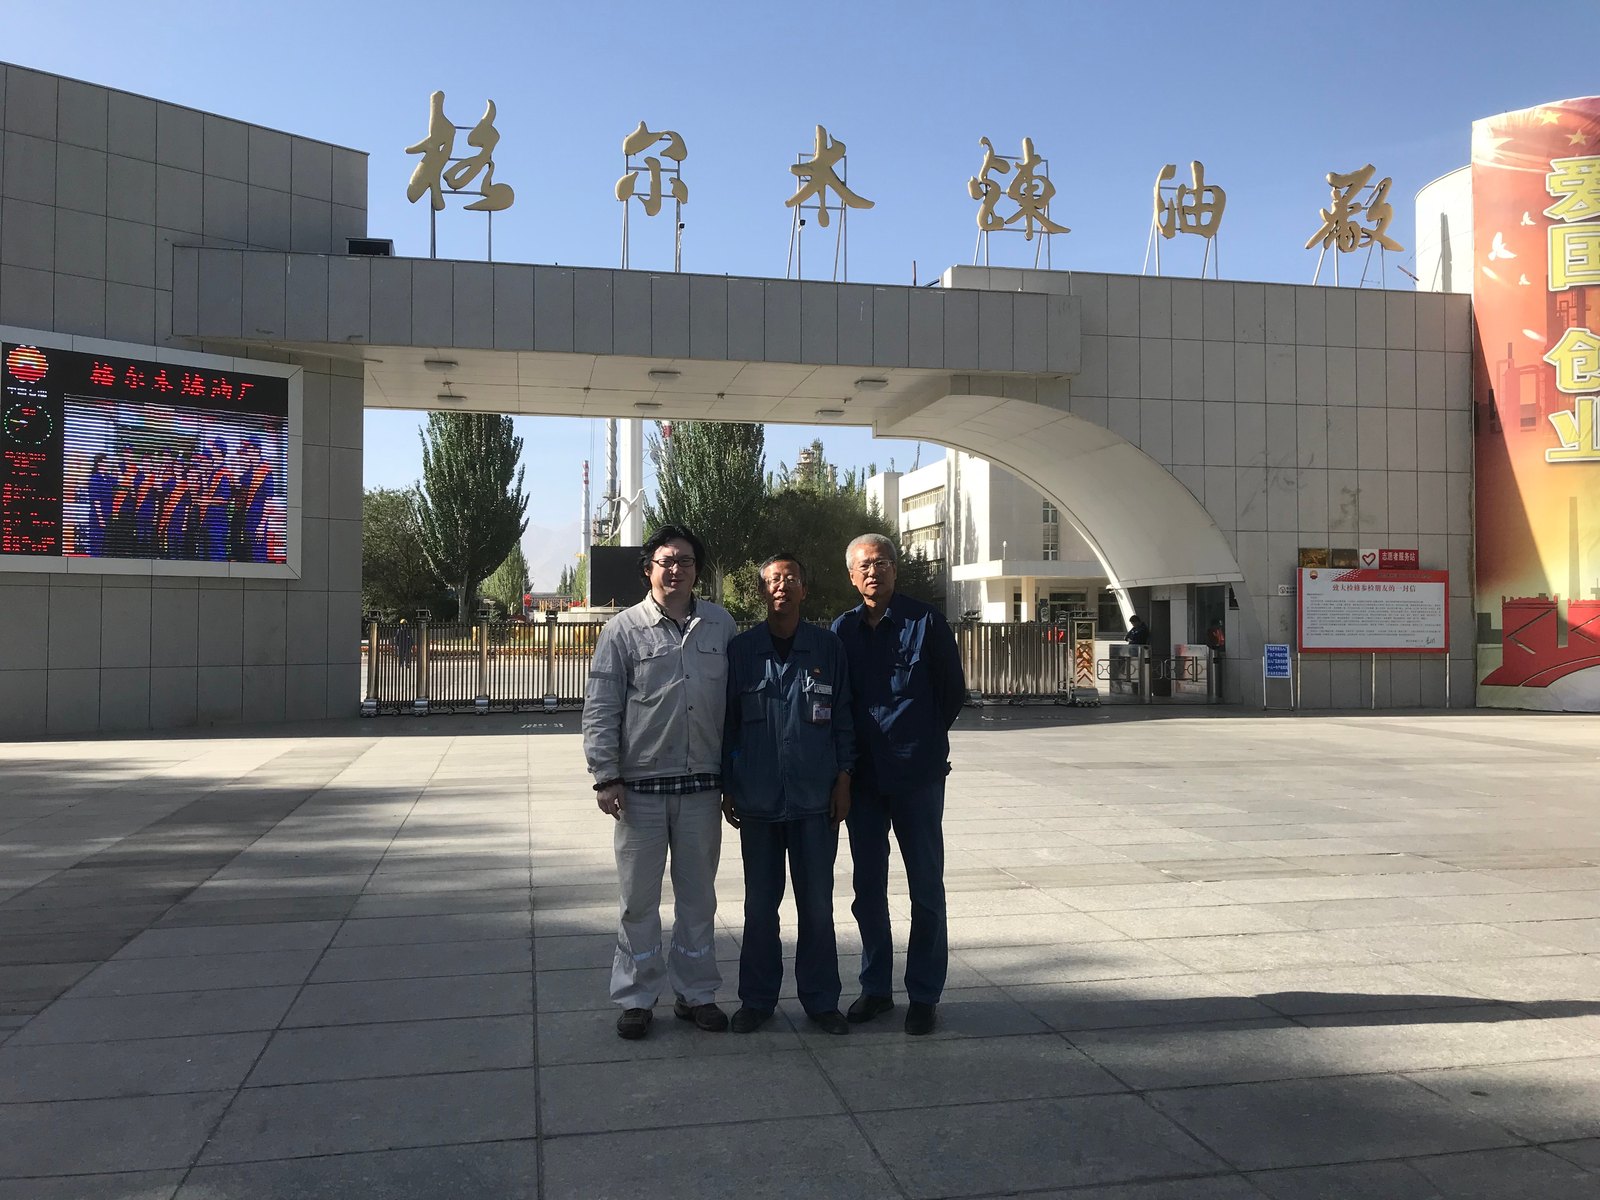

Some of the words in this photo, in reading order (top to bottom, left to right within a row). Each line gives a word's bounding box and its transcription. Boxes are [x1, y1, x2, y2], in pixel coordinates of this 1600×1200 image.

[1382, 551, 1416, 562] 志愿者服务站
